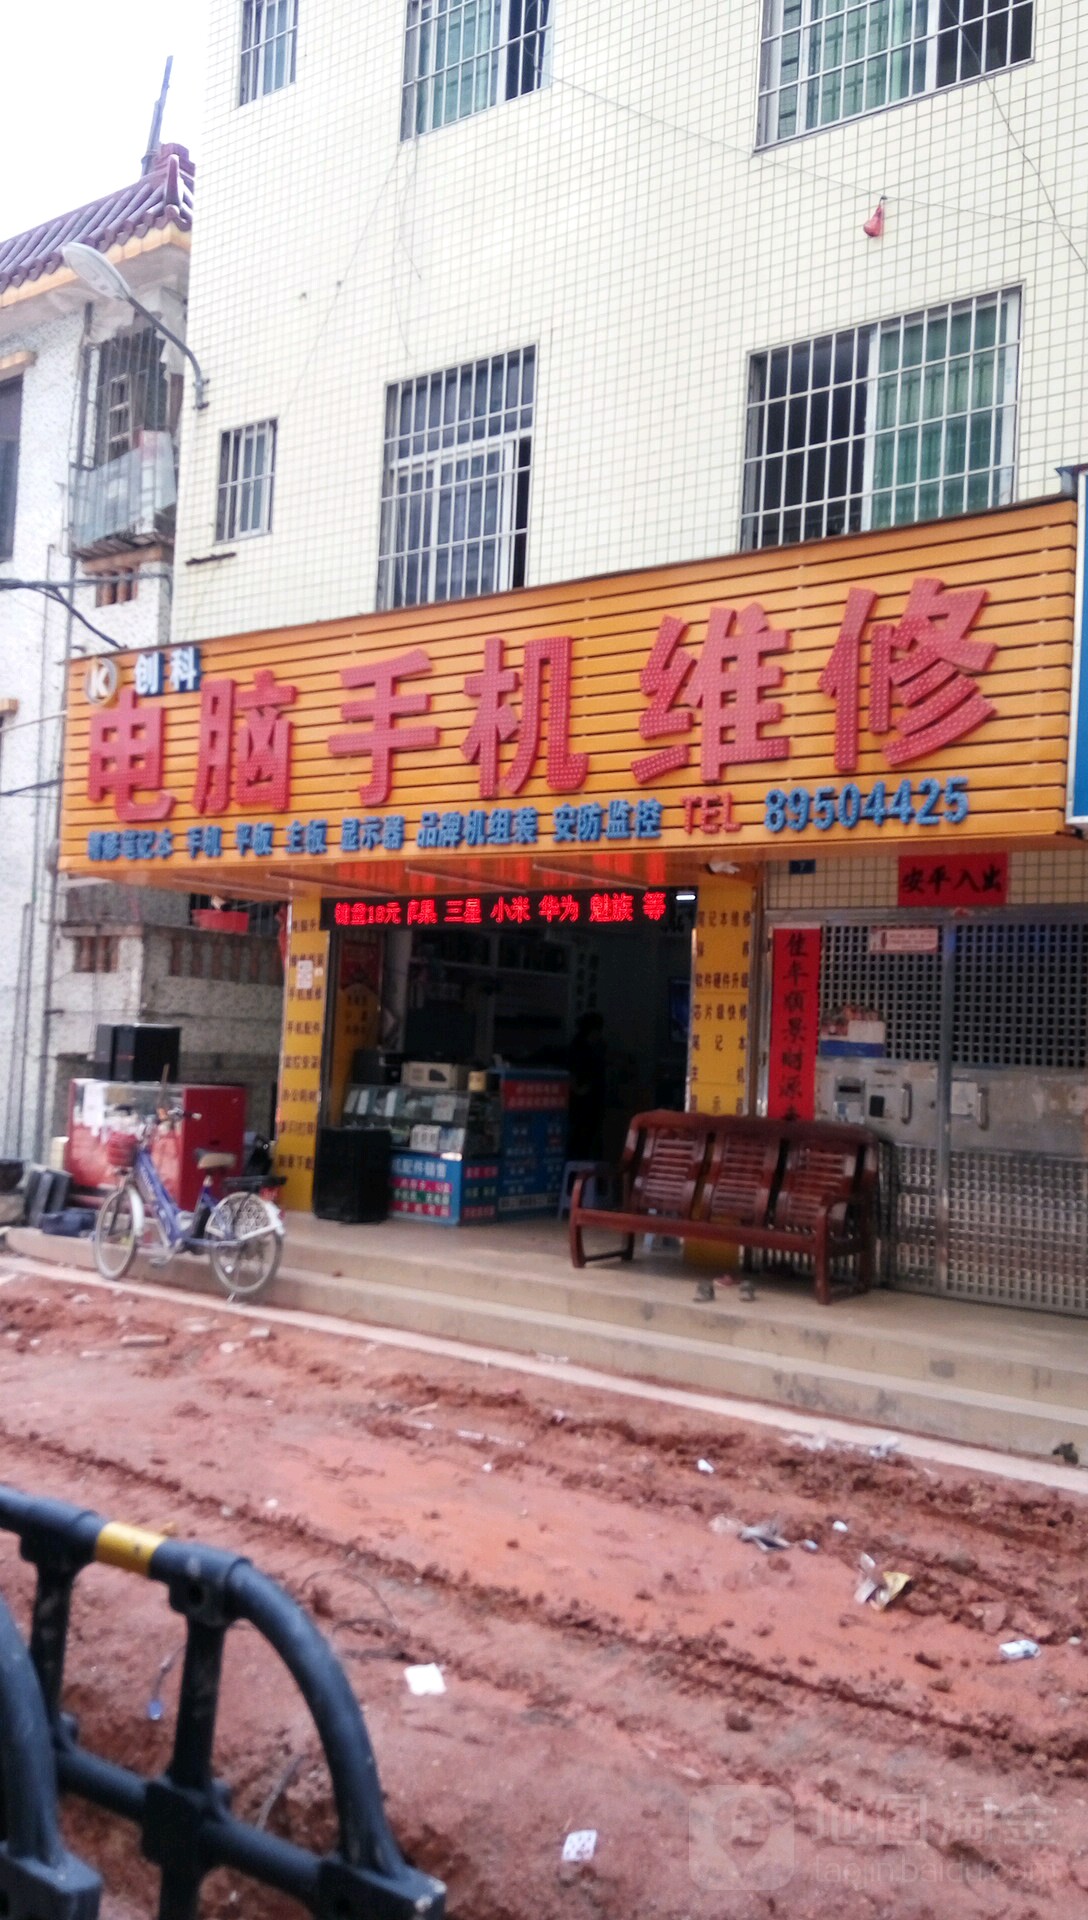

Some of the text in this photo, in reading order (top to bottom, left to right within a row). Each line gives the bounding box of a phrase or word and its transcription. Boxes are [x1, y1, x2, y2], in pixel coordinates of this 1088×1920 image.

[86, 576, 997, 822] 电脑手机维修
[134, 646, 200, 696] 创科
[186, 826, 223, 860] 手机
[236, 822, 274, 857] 平板
[286, 819, 328, 854] 主板
[341, 815, 405, 852] 显示器
[416, 807, 539, 848] 品牌机组装
[552, 797, 663, 843] 安防监控
[680, 776, 969, 834] TEL 89504425
[444, 898, 482, 923] 三星
[490, 895, 531, 924] 小米
[538, 894, 580, 923] 华为
[642, 891, 667, 921] 等
